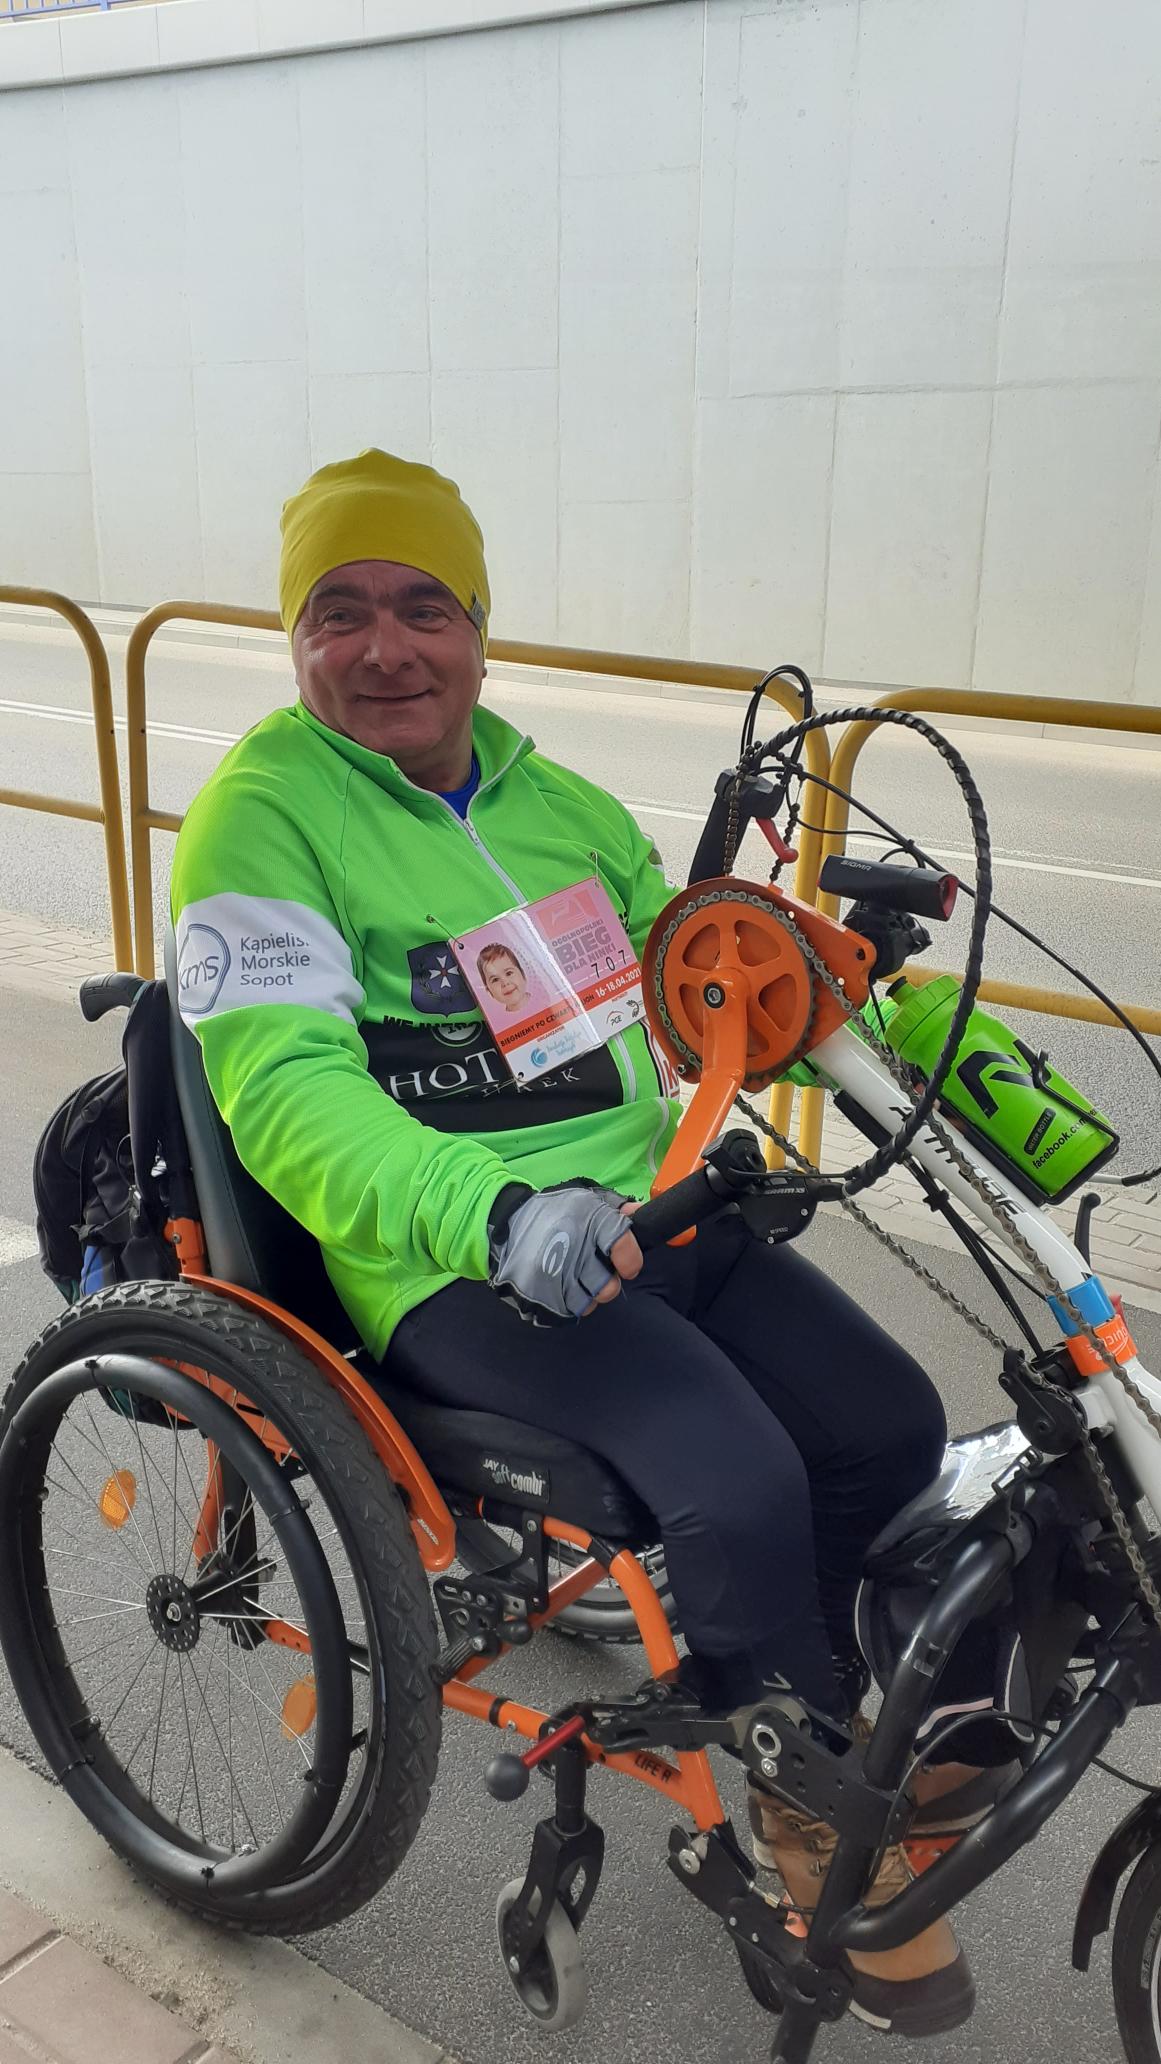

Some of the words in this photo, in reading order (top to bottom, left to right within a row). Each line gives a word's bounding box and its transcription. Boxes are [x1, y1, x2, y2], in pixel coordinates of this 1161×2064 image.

[554, 926, 612, 965] BIEG
[241, 951, 311, 971] Morskie
[564, 957, 588, 975] DLA
[587, 942, 617, 963] NINKI
[240, 972, 294, 988] Sopot
[536, 1020, 546, 1030] PO
[388, 1047, 500, 1101] HOT
[483, 1458, 500, 1471] JAY
[511, 1471, 543, 1497] combi
